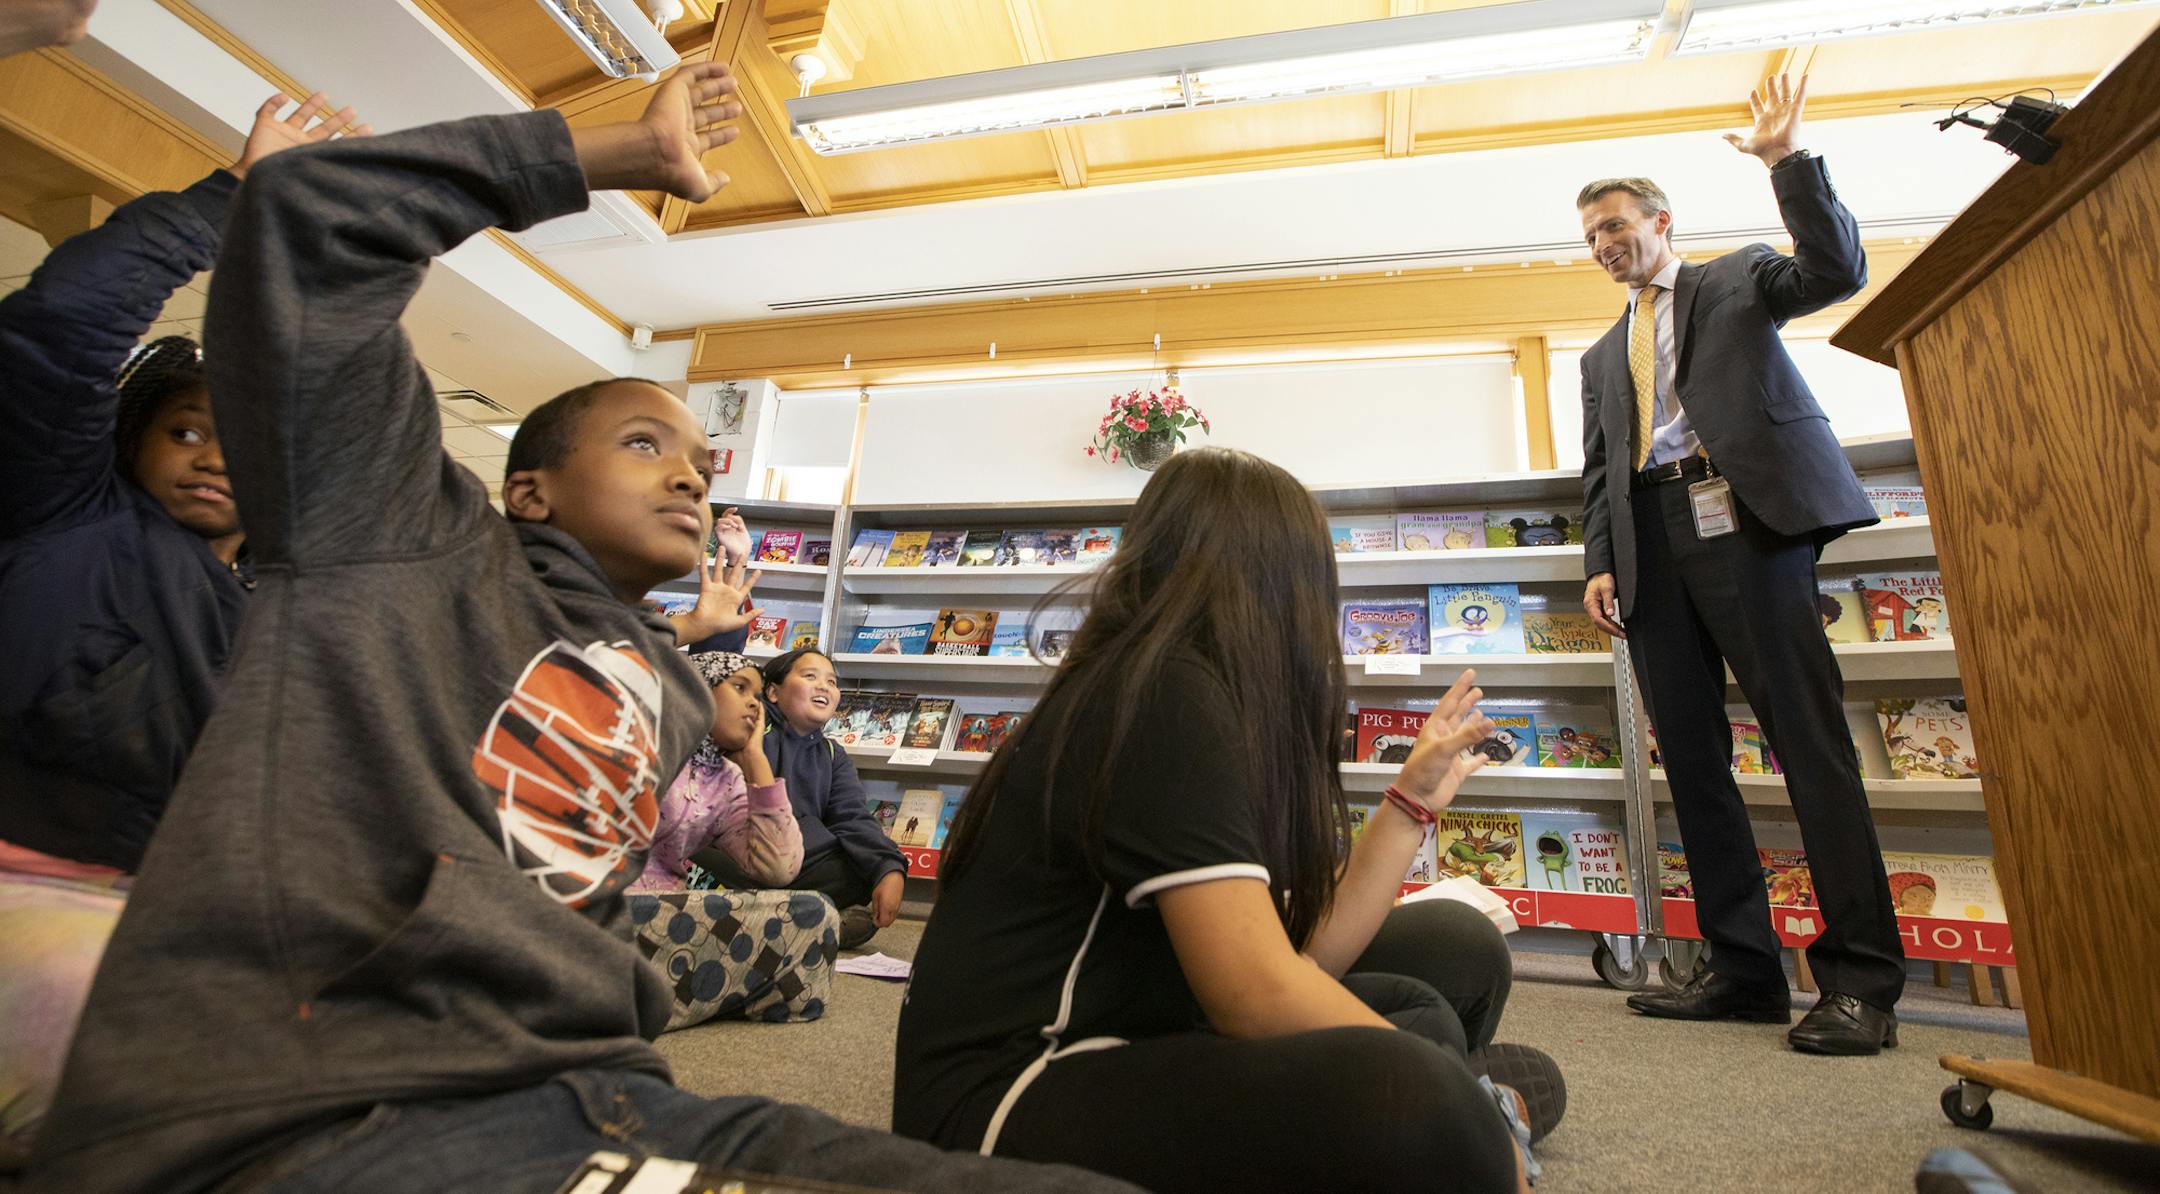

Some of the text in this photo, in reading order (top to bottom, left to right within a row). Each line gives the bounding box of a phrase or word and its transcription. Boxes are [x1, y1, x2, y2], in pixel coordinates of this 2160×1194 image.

[1880, 576, 1942, 587] The Littl
[1898, 586, 1944, 596] Red Fo
[1434, 591, 1517, 608] Little Penguin
[858, 629, 927, 639] CREATURES
[1362, 713, 1426, 729] PIG PU
[1916, 717, 1963, 732] PETS
[1481, 813, 1508, 821] GRETEL
[1441, 818, 1519, 837] NINJA CHICKS
[1572, 832, 1620, 844] I DON'T
[1580, 847, 1616, 858] WANT
[1578, 861, 1623, 872] TO BE A
[1582, 876, 1627, 894] FROG
